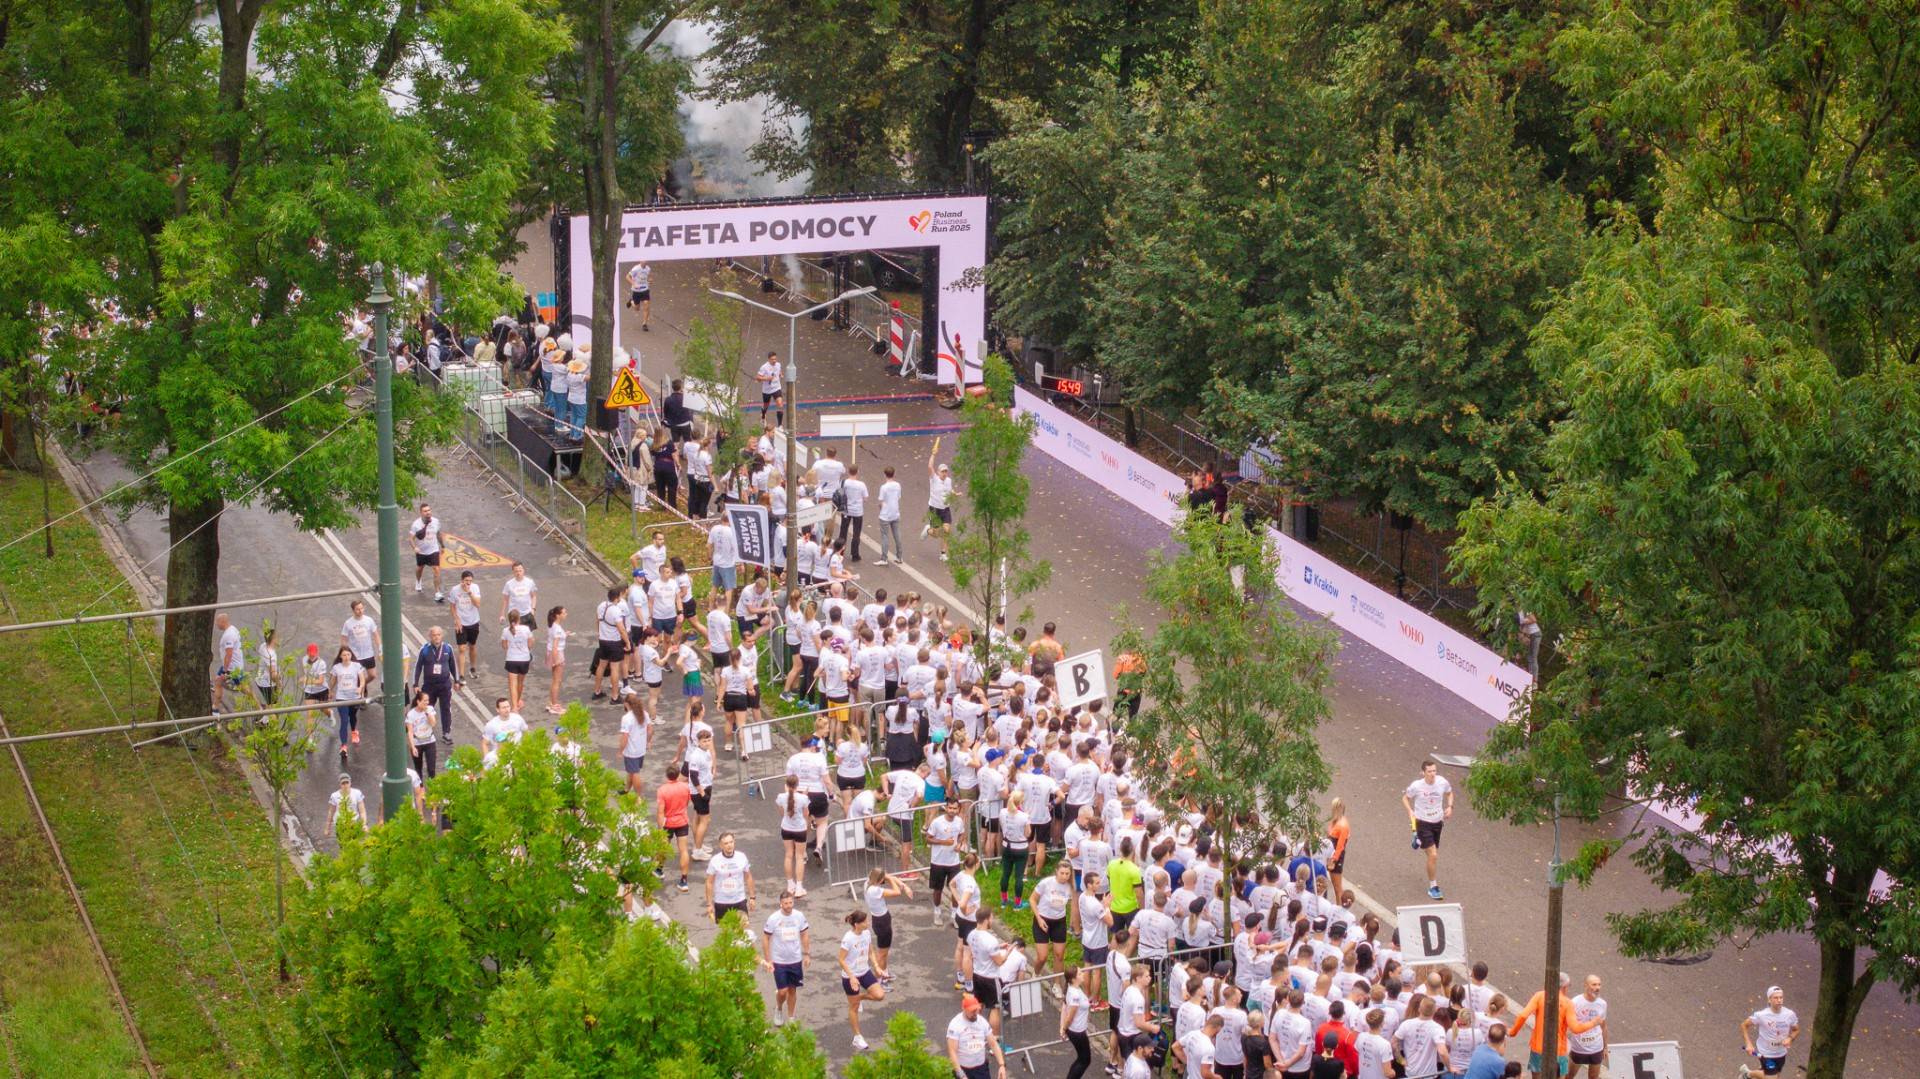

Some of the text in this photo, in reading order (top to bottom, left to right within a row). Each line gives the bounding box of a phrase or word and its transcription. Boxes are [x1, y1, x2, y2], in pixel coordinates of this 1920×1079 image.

[934, 210, 963, 219] Poland
[749, 215, 877, 242] POMOCY
[931, 224, 971, 233] Run 2025
[1314, 573, 1339, 598] Kraków
[1446, 648, 1478, 678] Betacom
[1072, 663, 1090, 697] B
[1419, 915, 1446, 957] D
